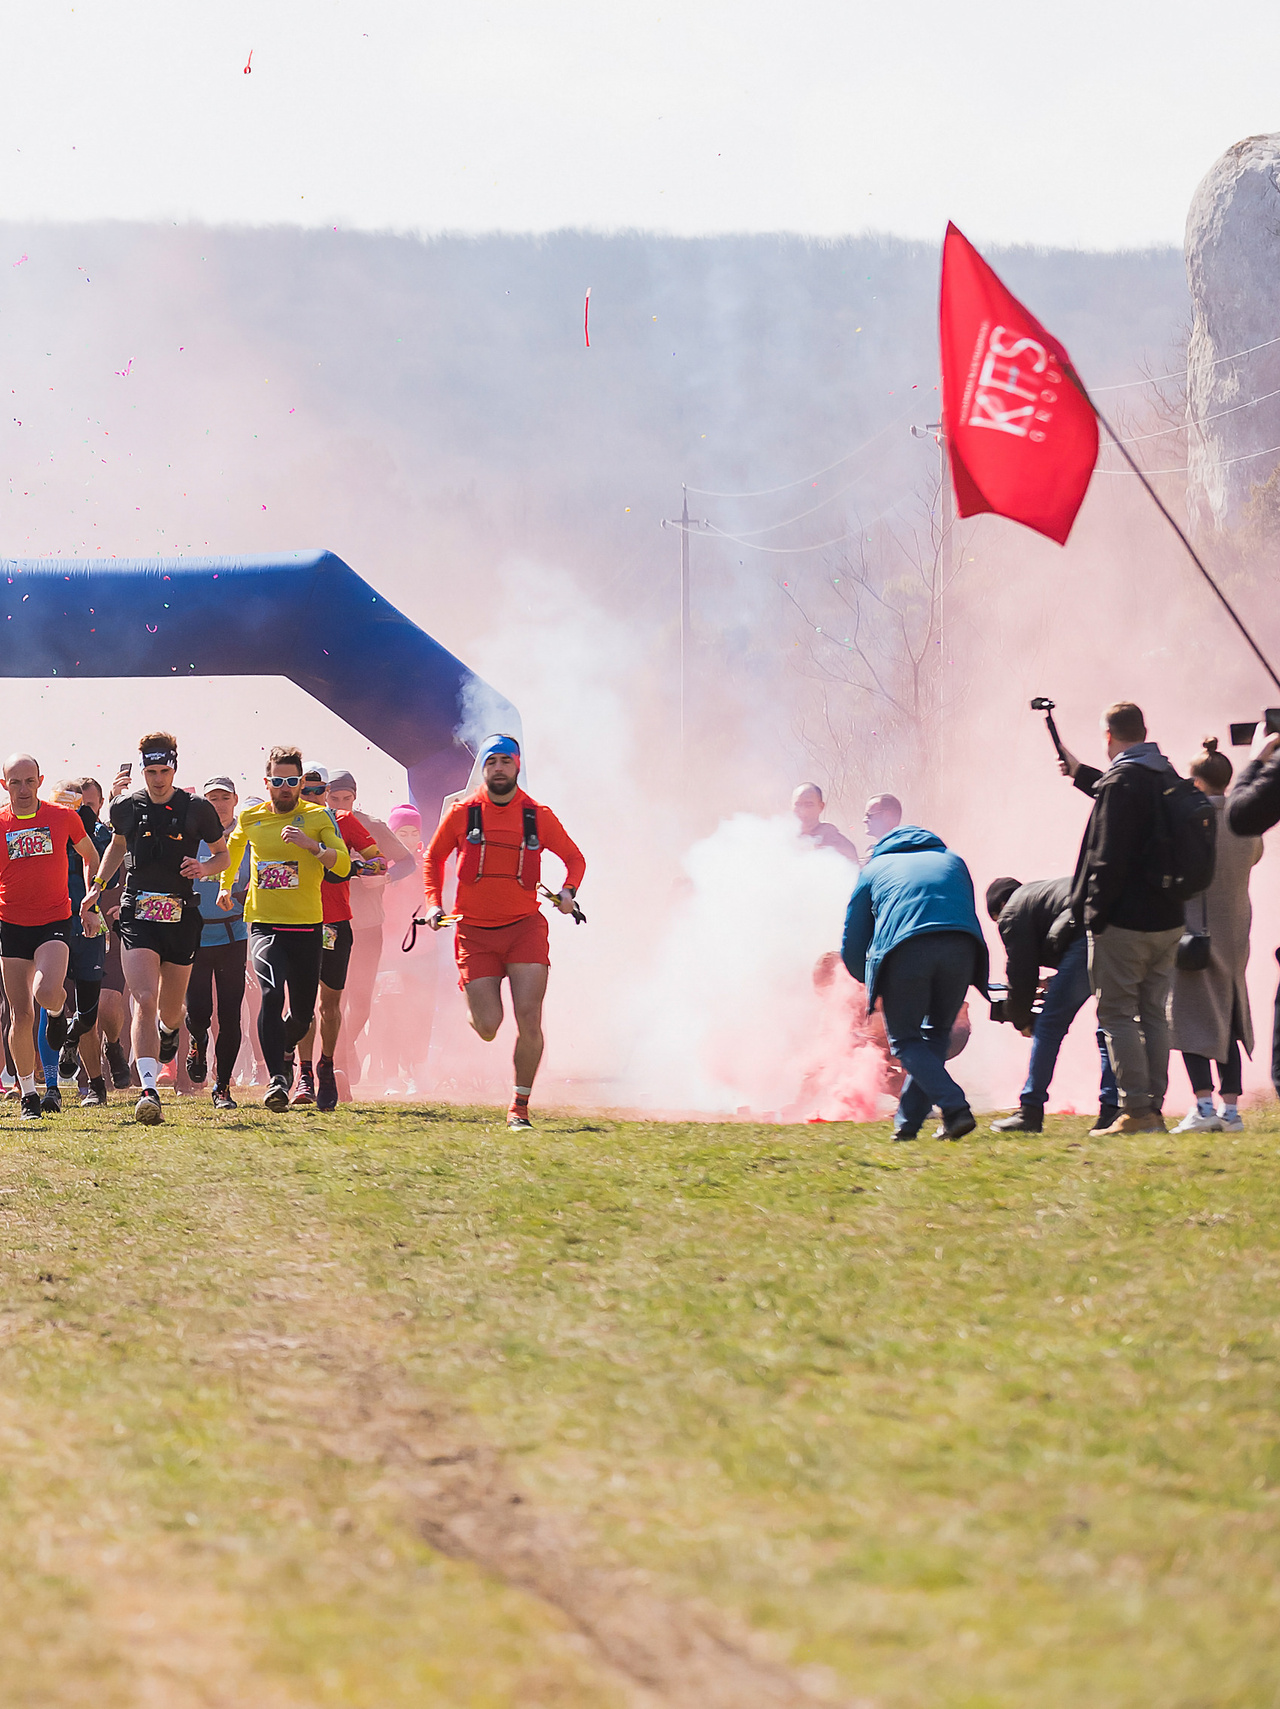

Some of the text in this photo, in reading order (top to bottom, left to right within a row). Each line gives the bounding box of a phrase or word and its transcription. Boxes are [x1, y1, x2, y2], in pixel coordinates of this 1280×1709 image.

[968, 325, 1047, 437] KFS
[16, 836, 43, 856] 105
[264, 869, 289, 887] 226
[145, 901, 172, 920] 228
